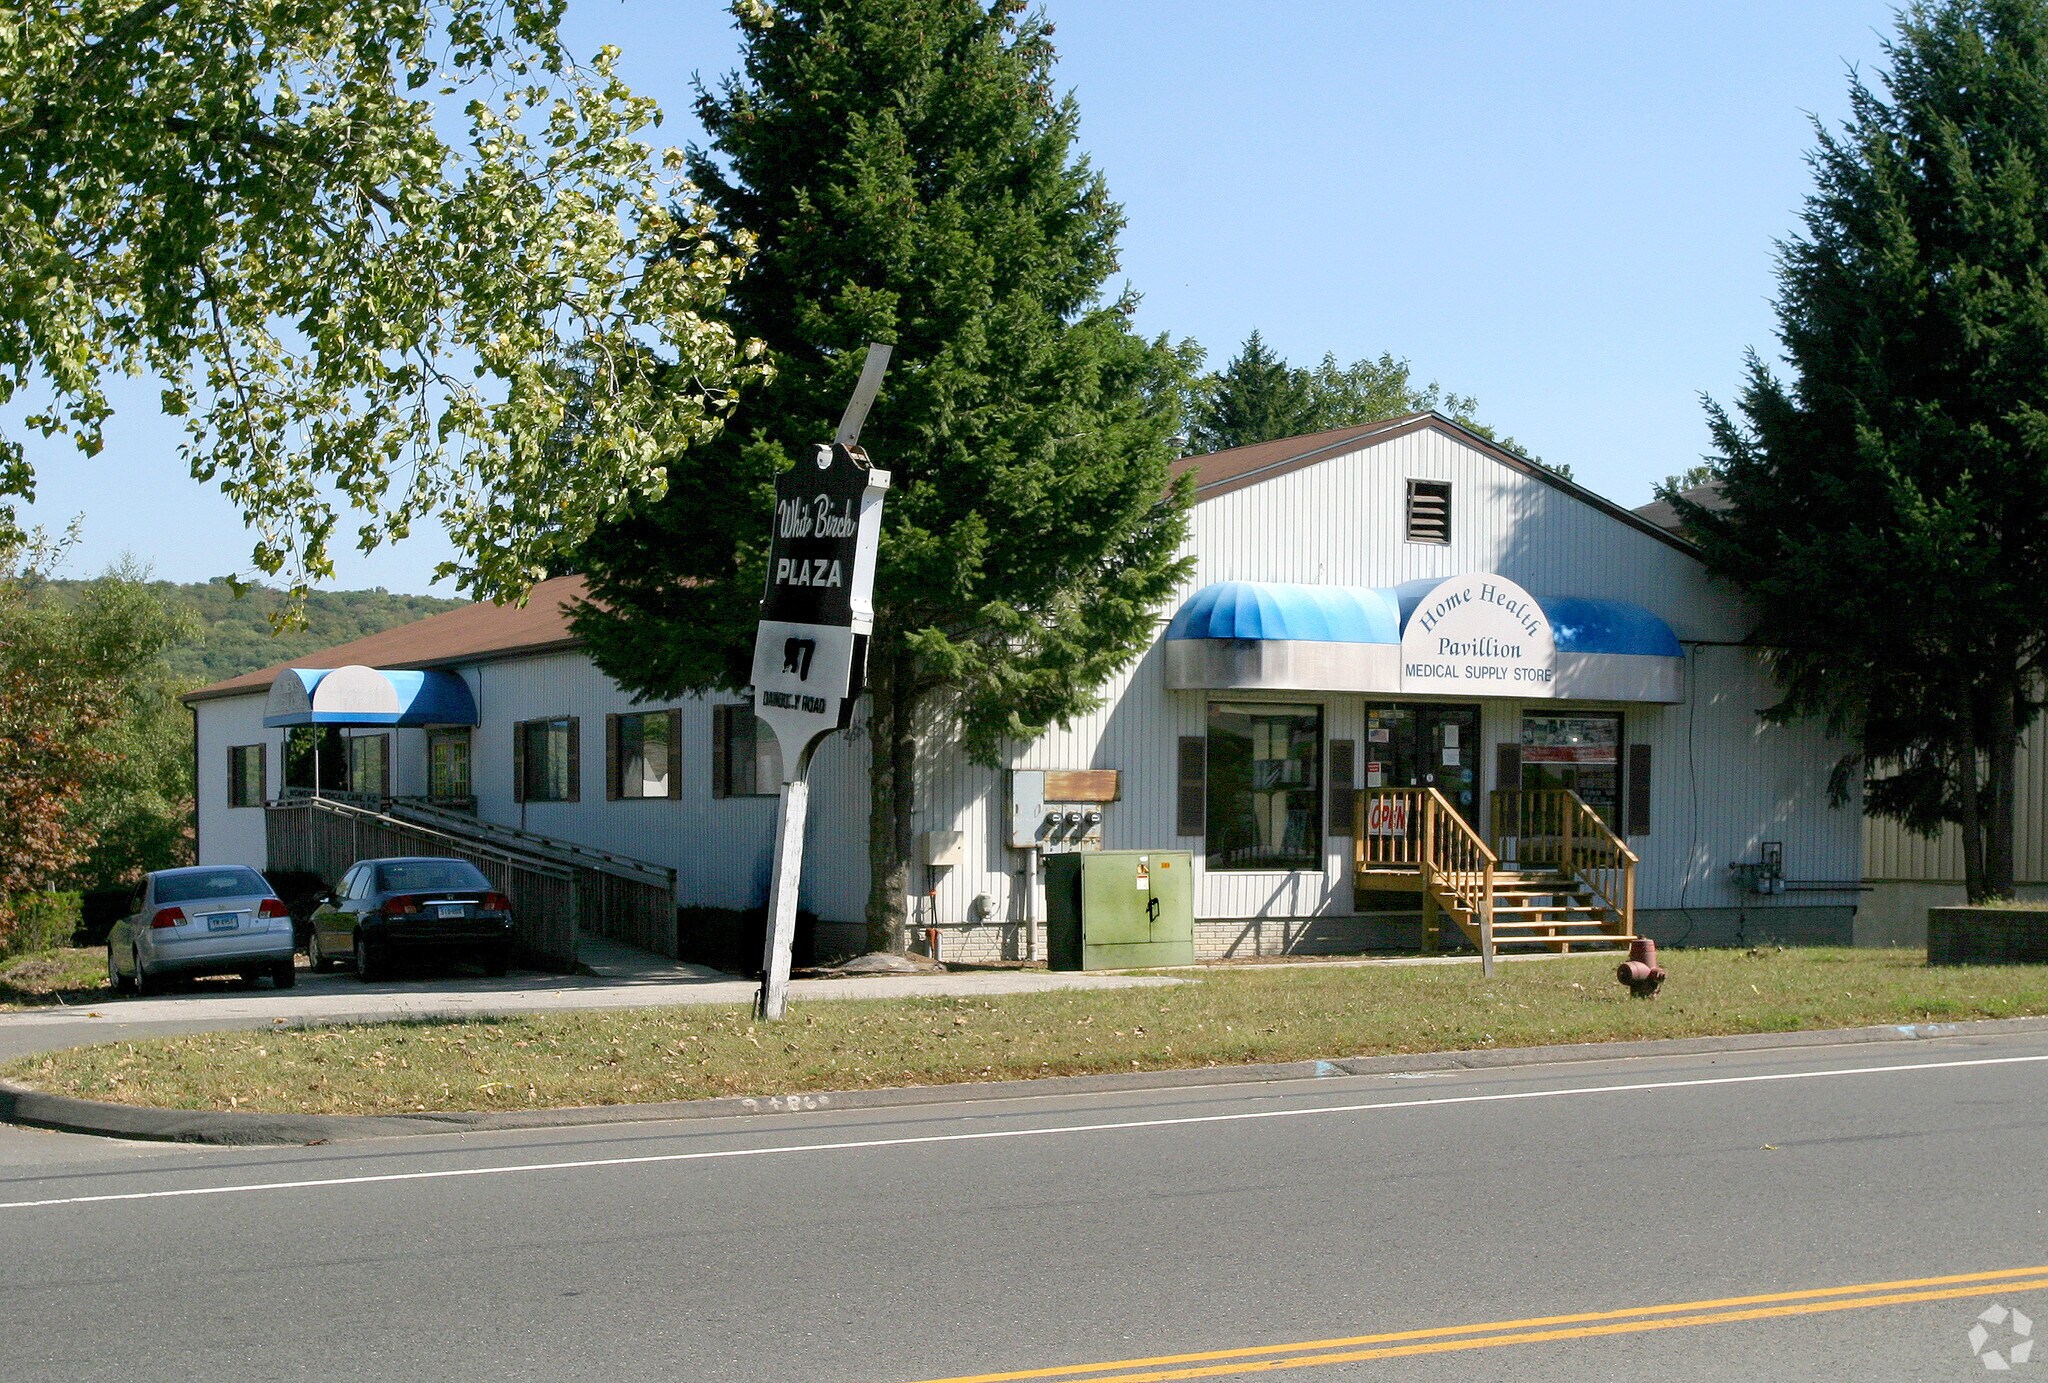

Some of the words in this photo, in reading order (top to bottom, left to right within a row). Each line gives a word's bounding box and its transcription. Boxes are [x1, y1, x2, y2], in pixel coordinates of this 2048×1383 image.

[777, 496, 813, 538] White
[814, 493, 857, 538] Birch
[775, 558, 841, 587] PLAZA
[1418, 588, 1472, 634] Home
[1479, 583, 1541, 638] Health
[1437, 636, 1522, 658] Pavillion
[1405, 663, 1459, 679] MEDICAL
[1465, 665, 1508, 680] SUPPLY
[1513, 667, 1552, 682] STORE
[801, 694, 827, 714] ROAD
